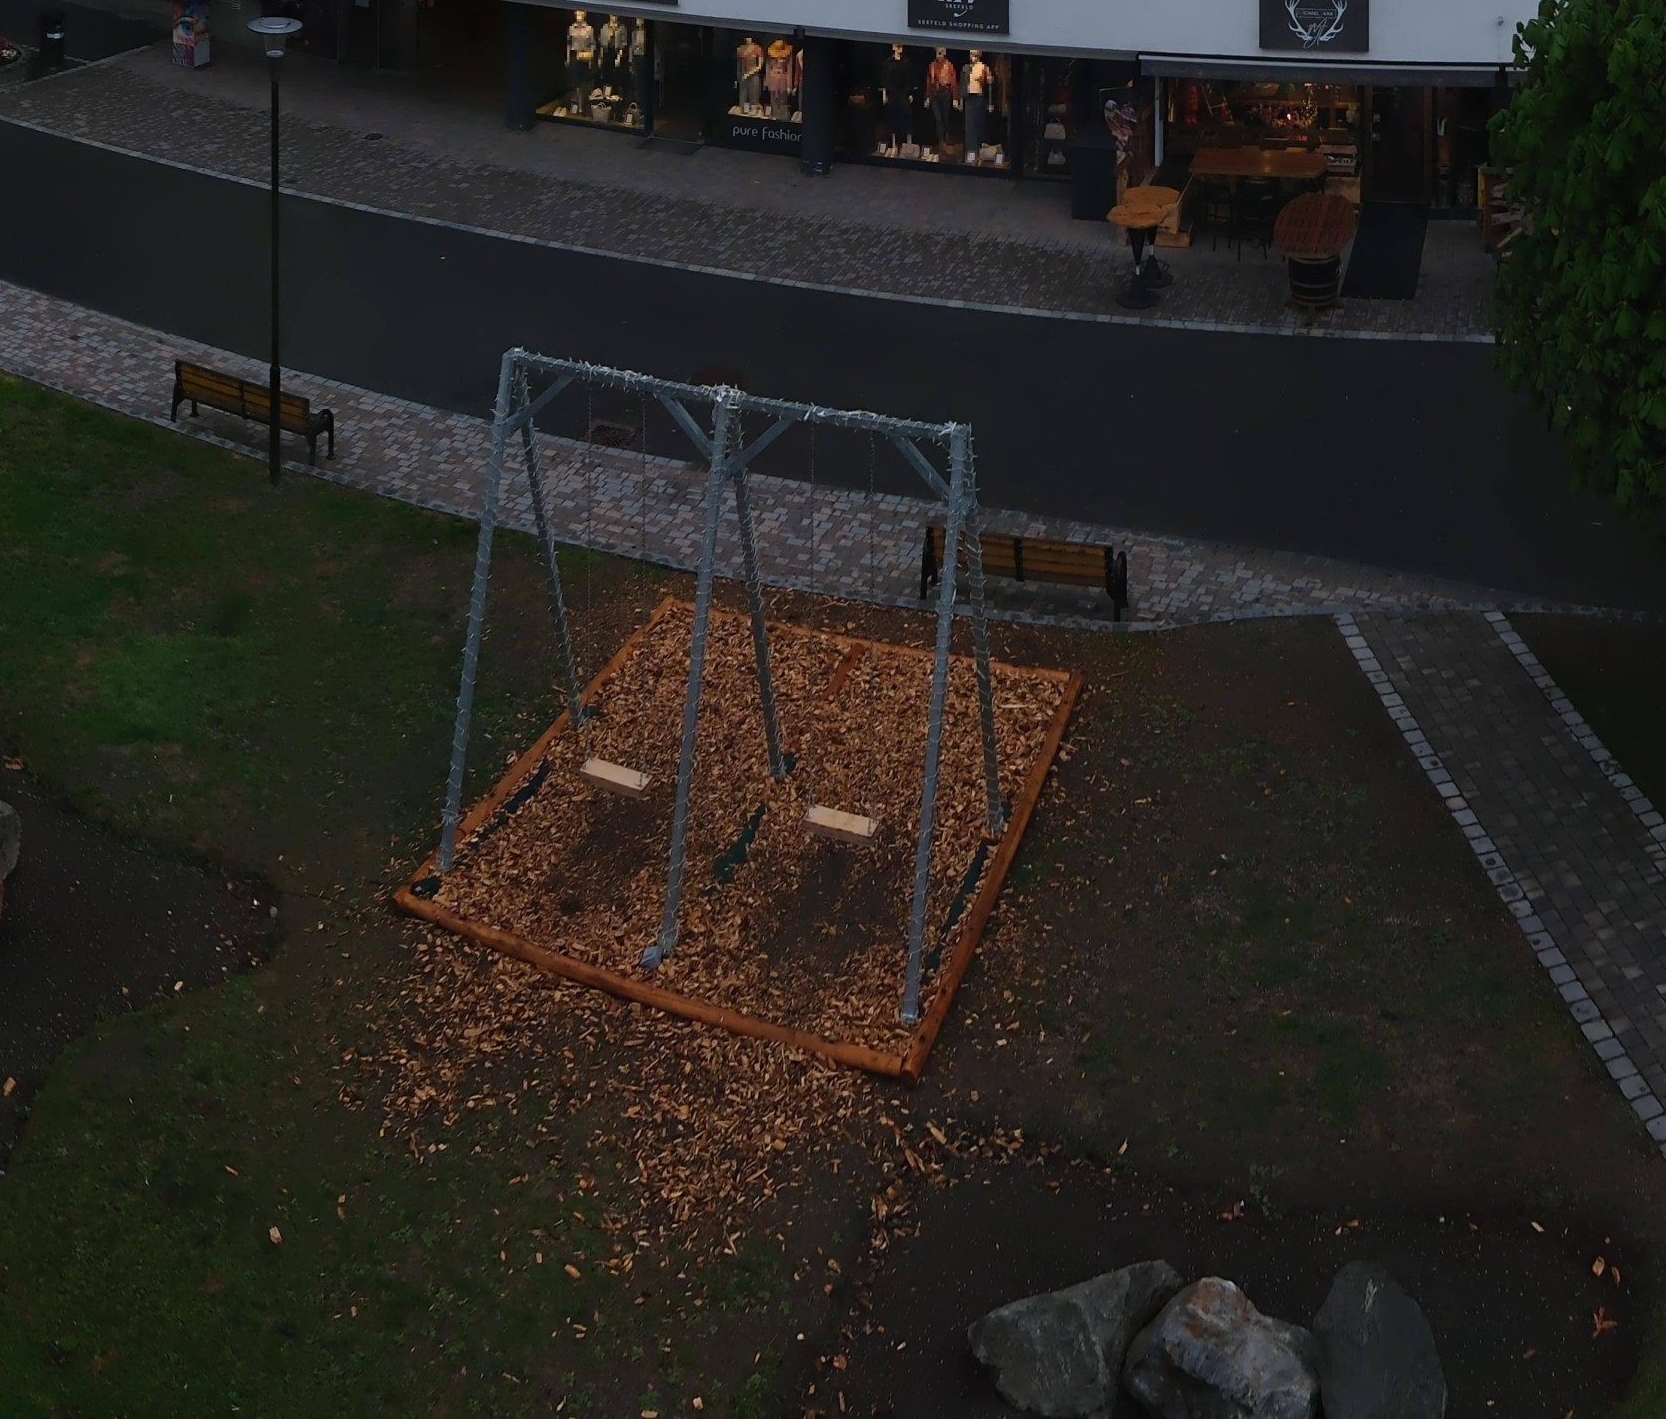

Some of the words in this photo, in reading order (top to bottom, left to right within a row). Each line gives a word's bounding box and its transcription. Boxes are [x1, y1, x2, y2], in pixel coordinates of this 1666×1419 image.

[945, 3, 974, 11] SEEFELD
[918, 19, 947, 27] SEEFELD
[949, 21, 984, 29] SHOPPING
[733, 125, 759, 137] pure
